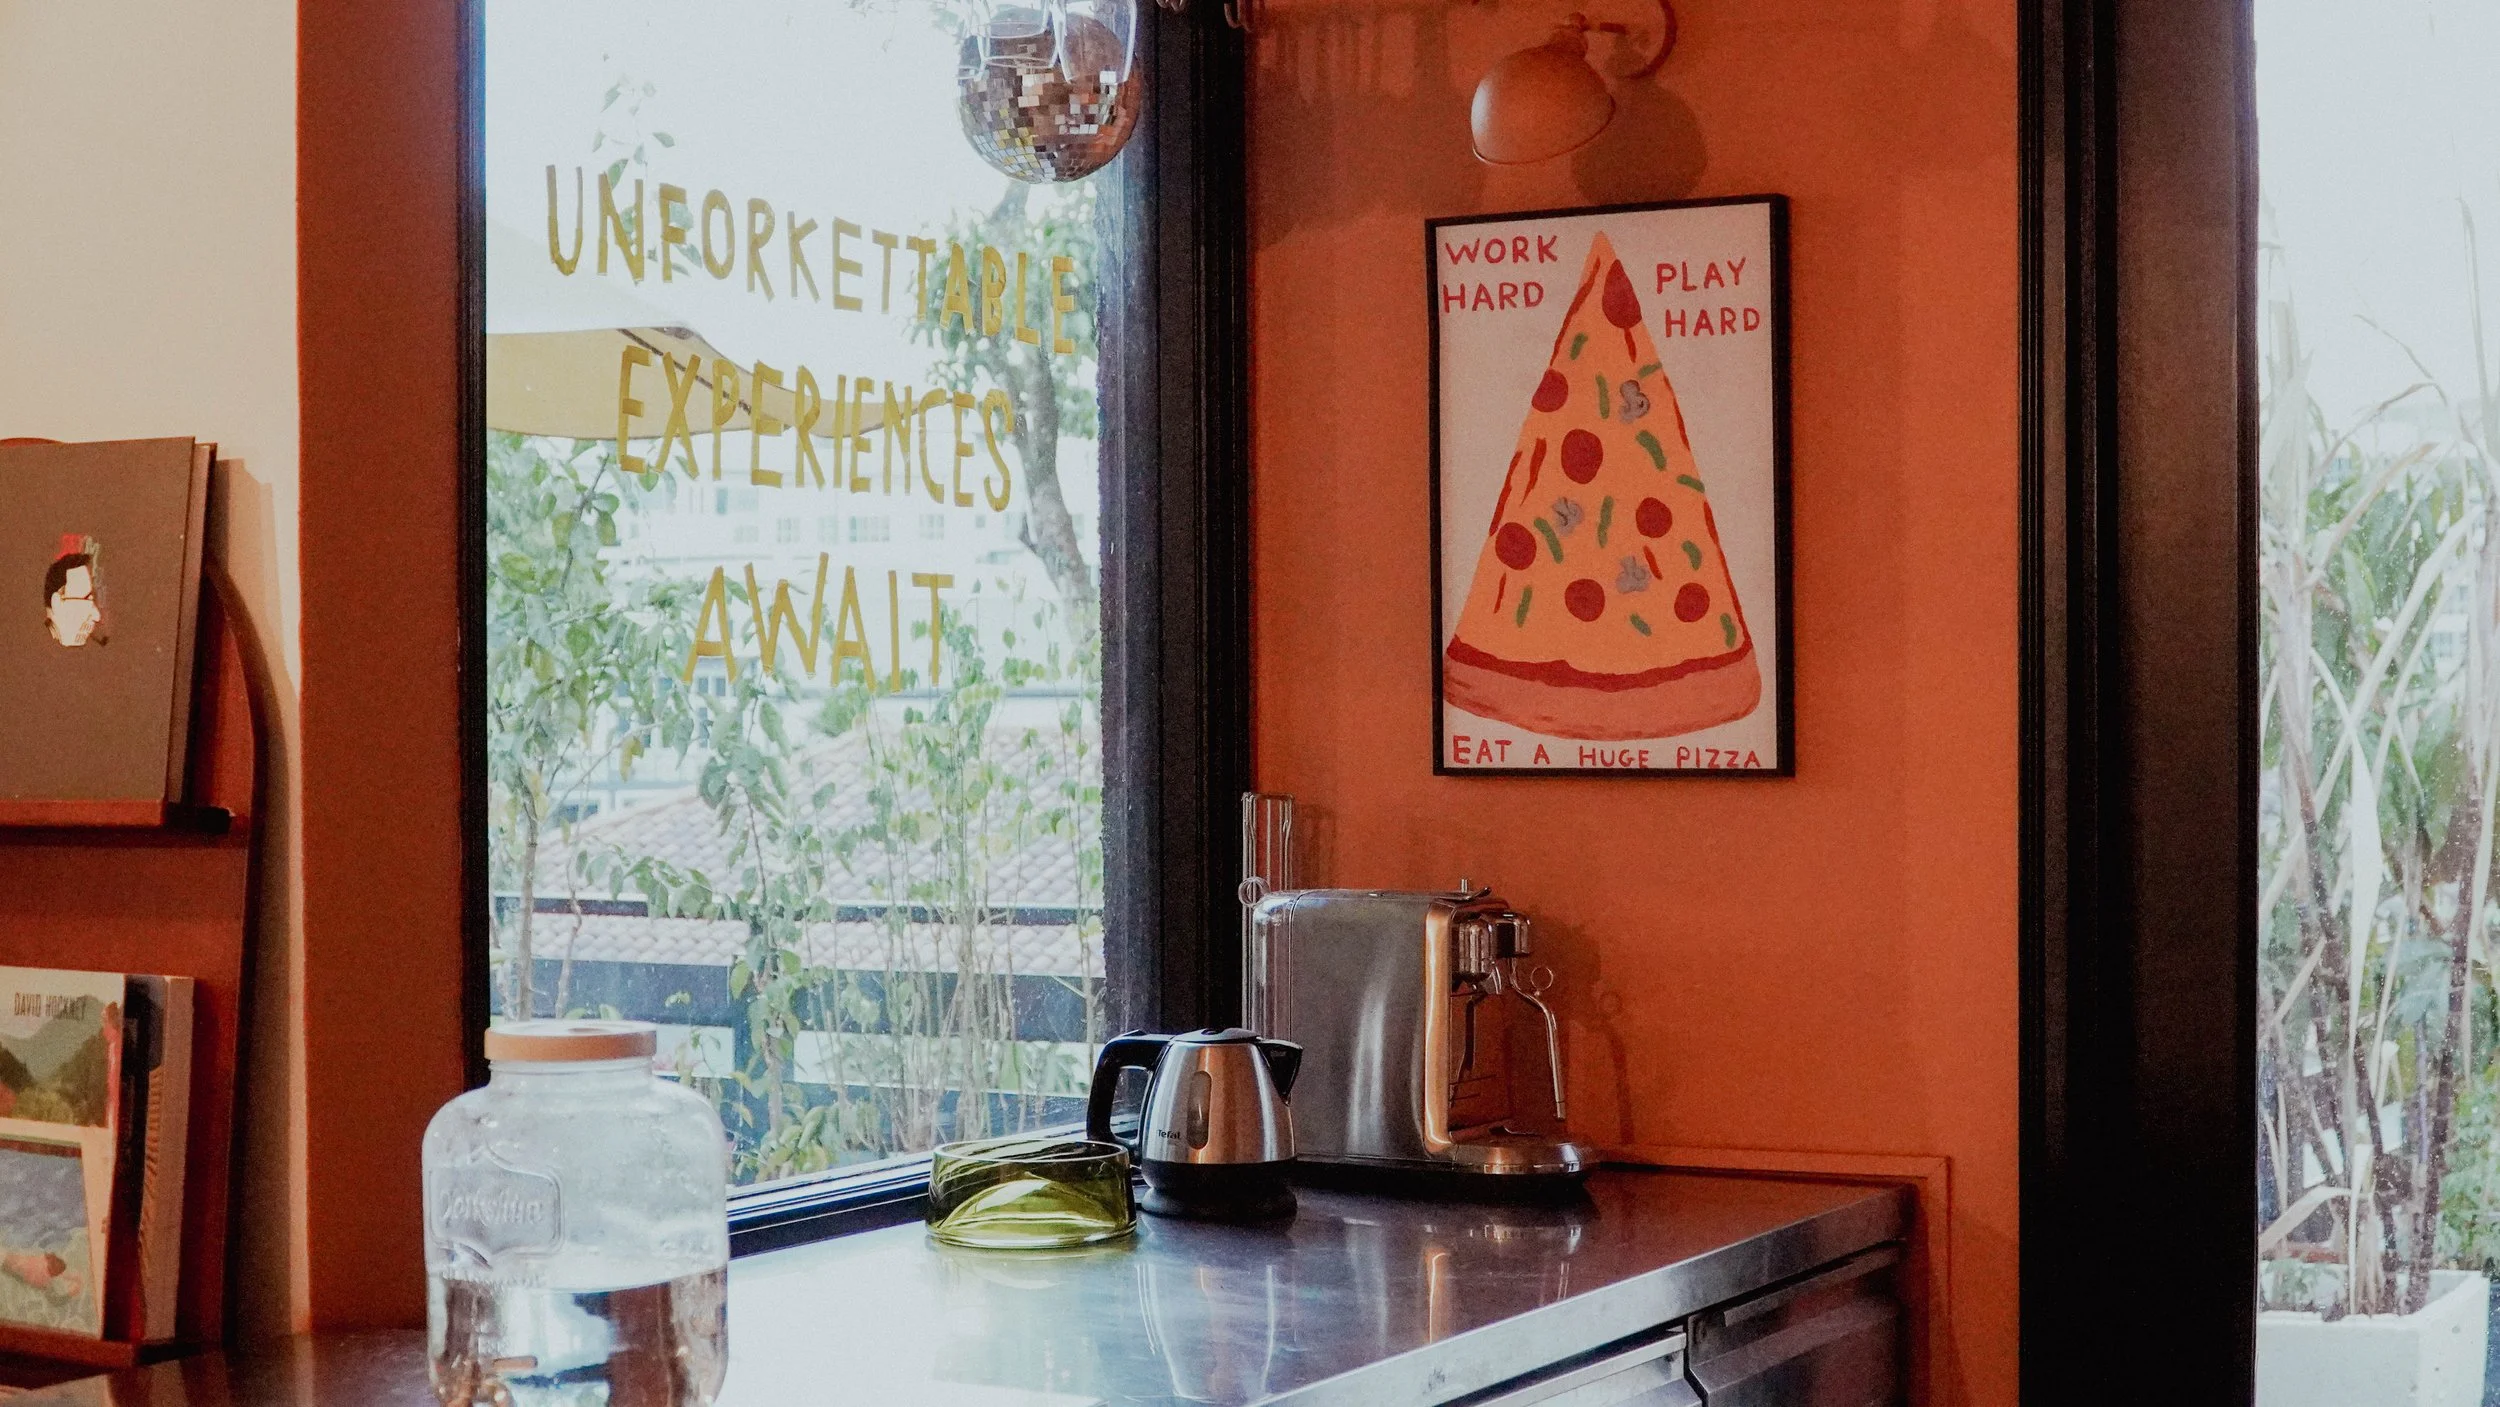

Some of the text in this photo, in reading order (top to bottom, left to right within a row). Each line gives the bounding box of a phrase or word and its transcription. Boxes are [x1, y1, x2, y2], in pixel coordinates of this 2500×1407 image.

[545, 164, 1076, 355] UNFORKETTABLE
[1445, 234, 1558, 265] WORK
[1656, 257, 1747, 294] PLAY
[1442, 281, 1545, 313] HARD
[1665, 306, 1761, 338] HARD
[617, 344, 1014, 513] EXPERIENCES
[682, 551, 954, 694] AWAIT
[1452, 735, 1762, 768] EAT A HUGE PIZZA
[14, 992, 42, 1017] DAVID
[1157, 1129, 1181, 1139] Tefal
